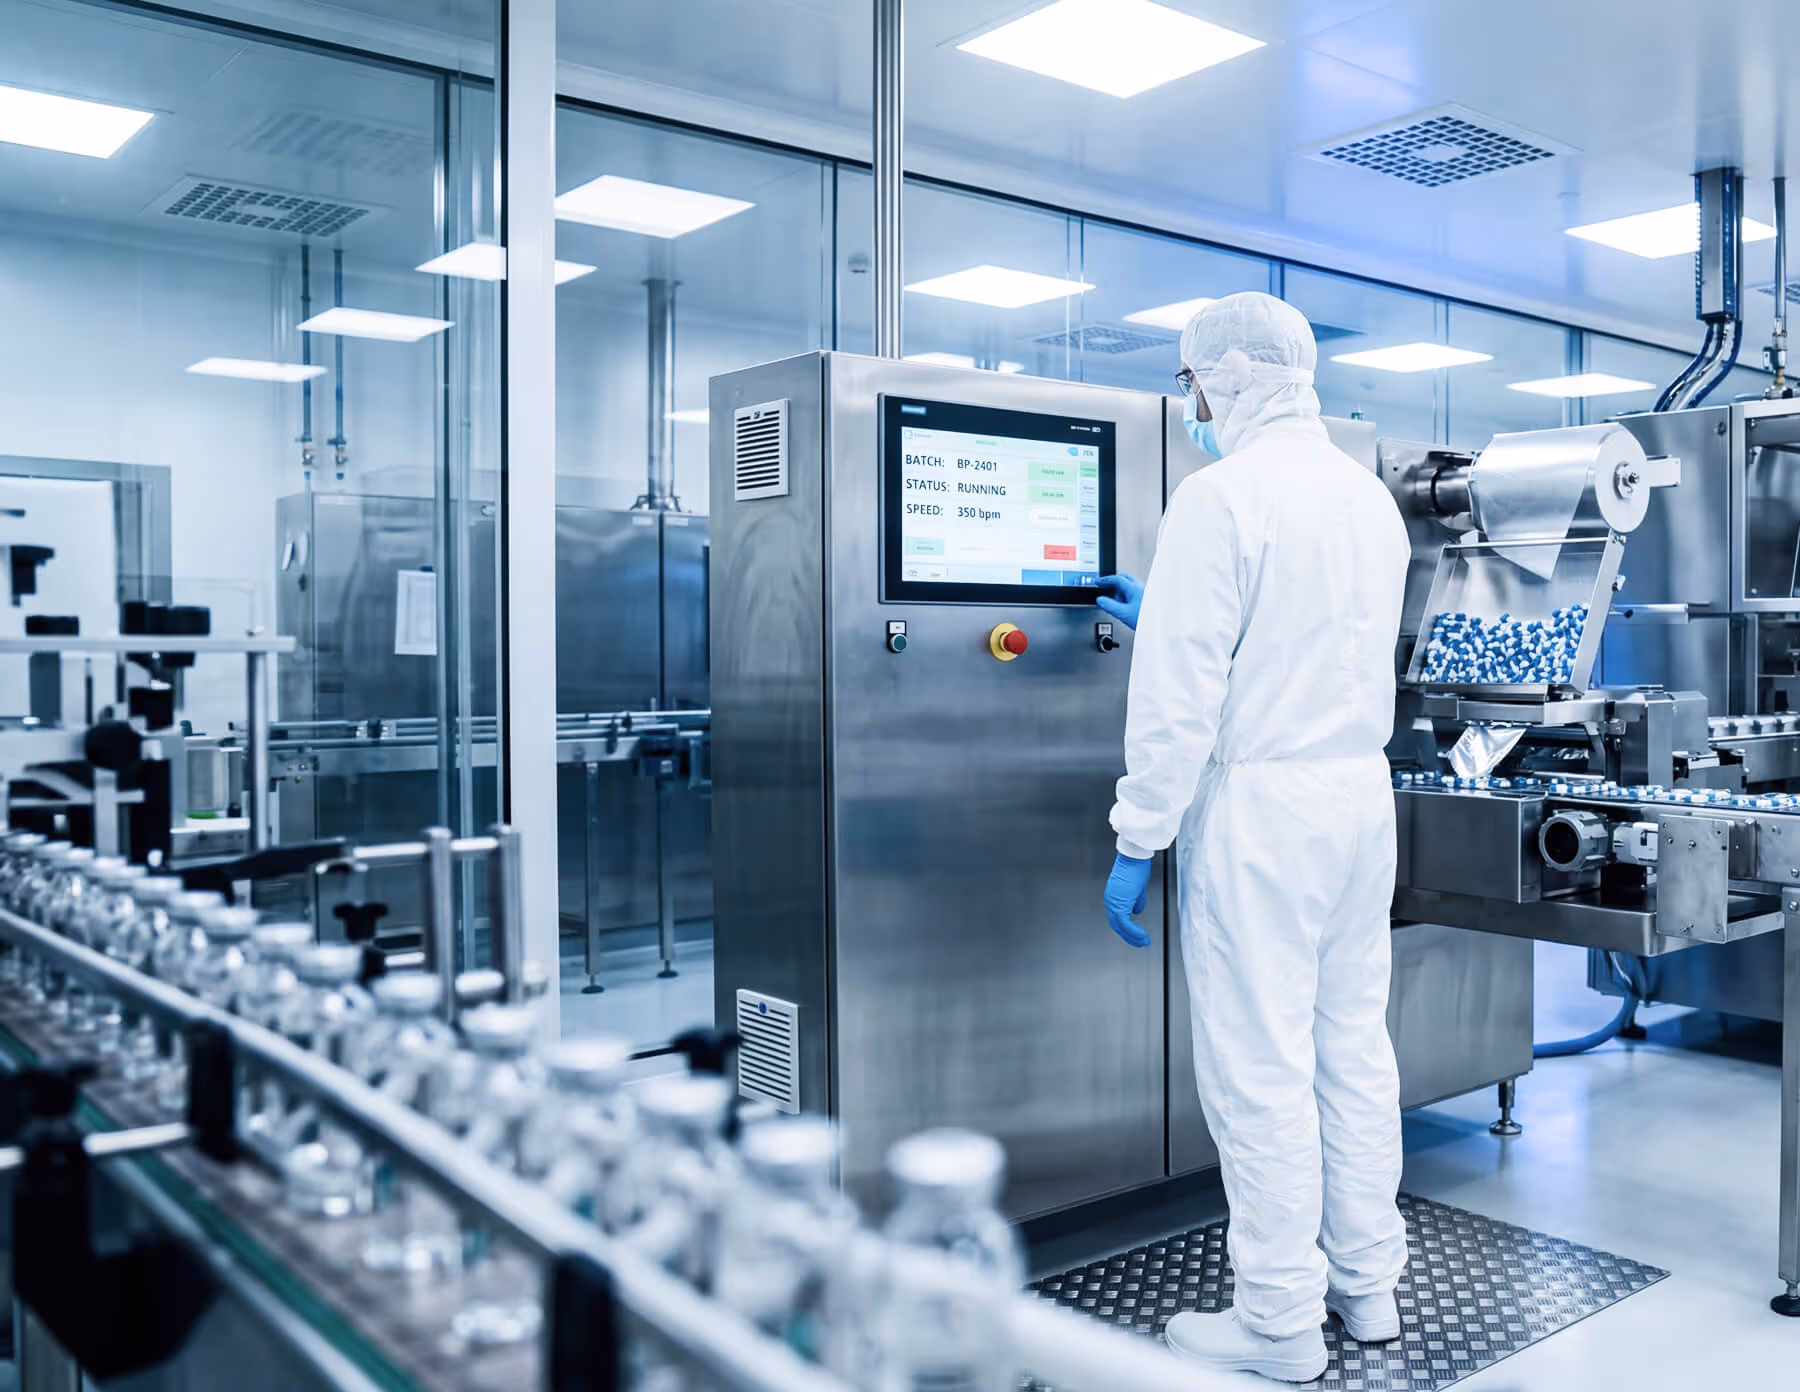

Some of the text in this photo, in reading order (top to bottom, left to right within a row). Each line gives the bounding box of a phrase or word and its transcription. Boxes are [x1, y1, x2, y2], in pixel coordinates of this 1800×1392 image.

[906, 454, 997, 471] BATCH: BP-2401
[906, 479, 1006, 495] STATUS: RUNNING
[906, 504, 1001, 520] SPEED: 350 bpm
